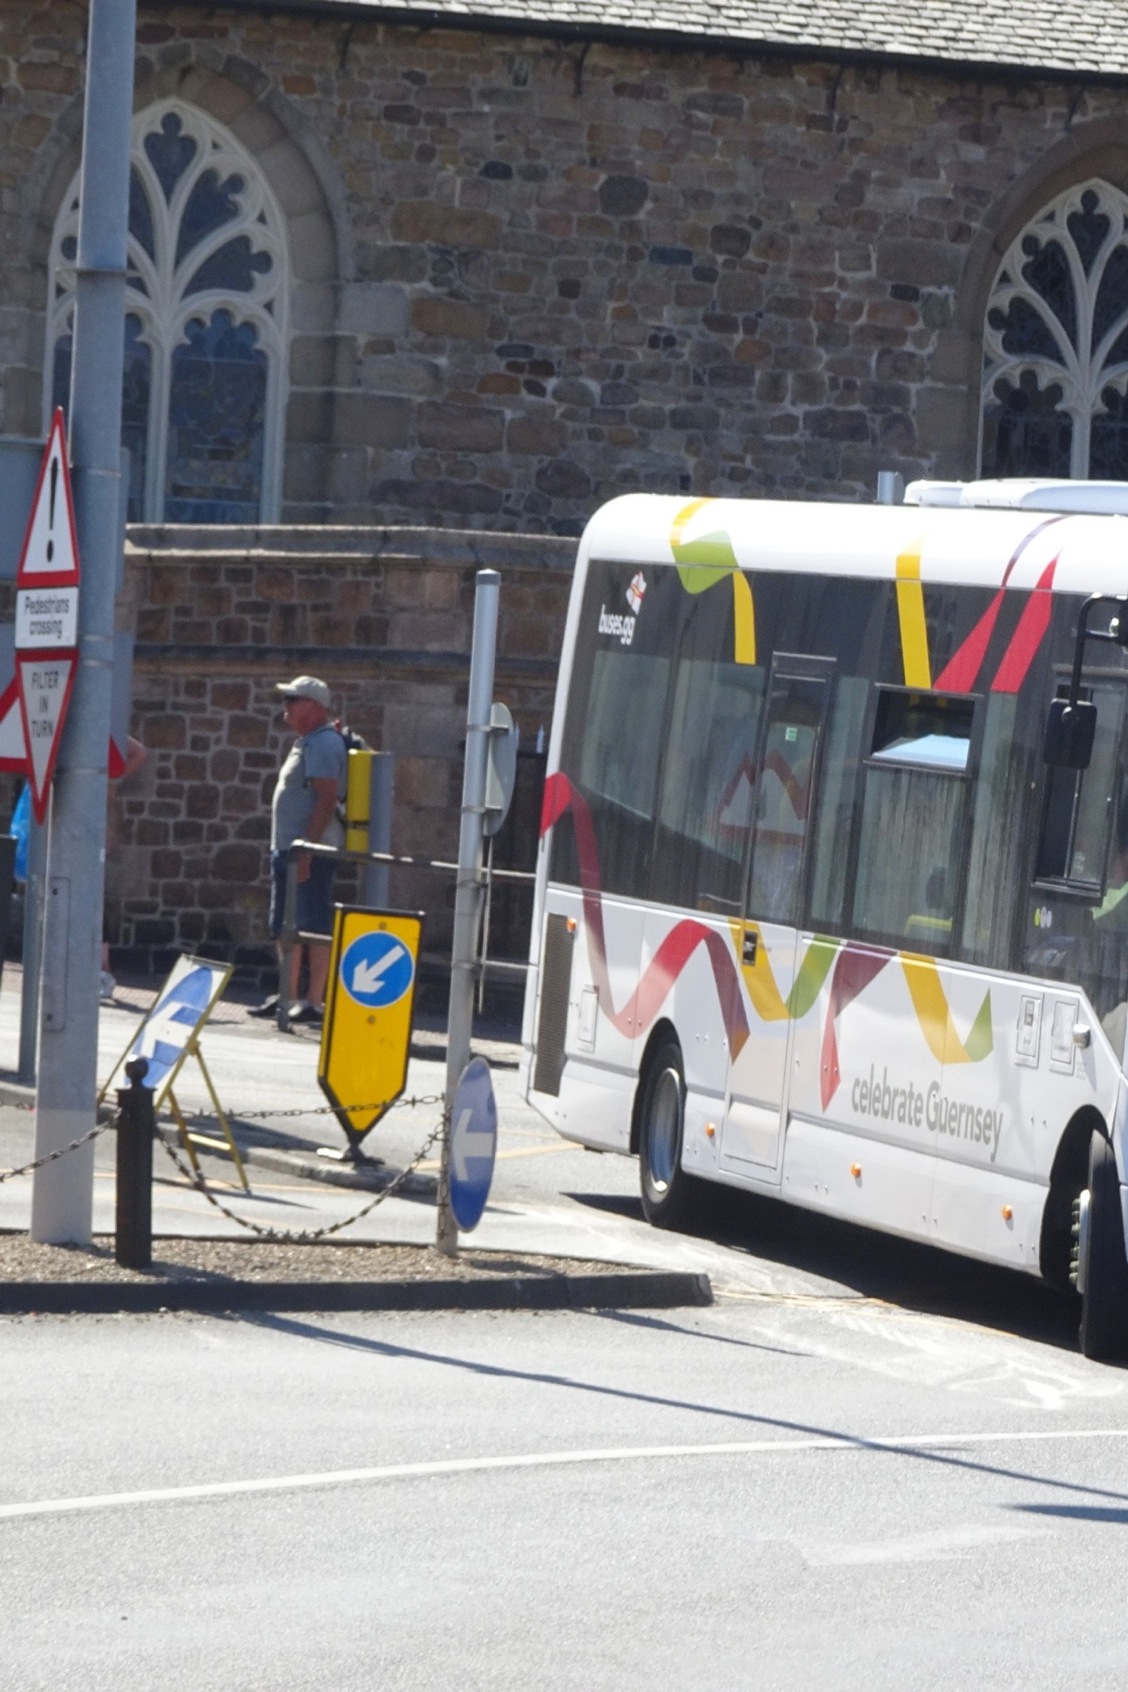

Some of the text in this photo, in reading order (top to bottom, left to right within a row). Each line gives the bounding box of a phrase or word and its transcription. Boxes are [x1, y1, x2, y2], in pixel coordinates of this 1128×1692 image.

[25, 596, 70, 614] Pedestrians
[29, 618, 63, 640] crossing
[598, 603, 636, 645] buses.gg
[31, 671, 59, 689] FILTER
[39, 696, 48, 713] IN
[31, 720, 53, 737] TURN
[851, 1063, 1003, 1163] celebrate Guernsey
